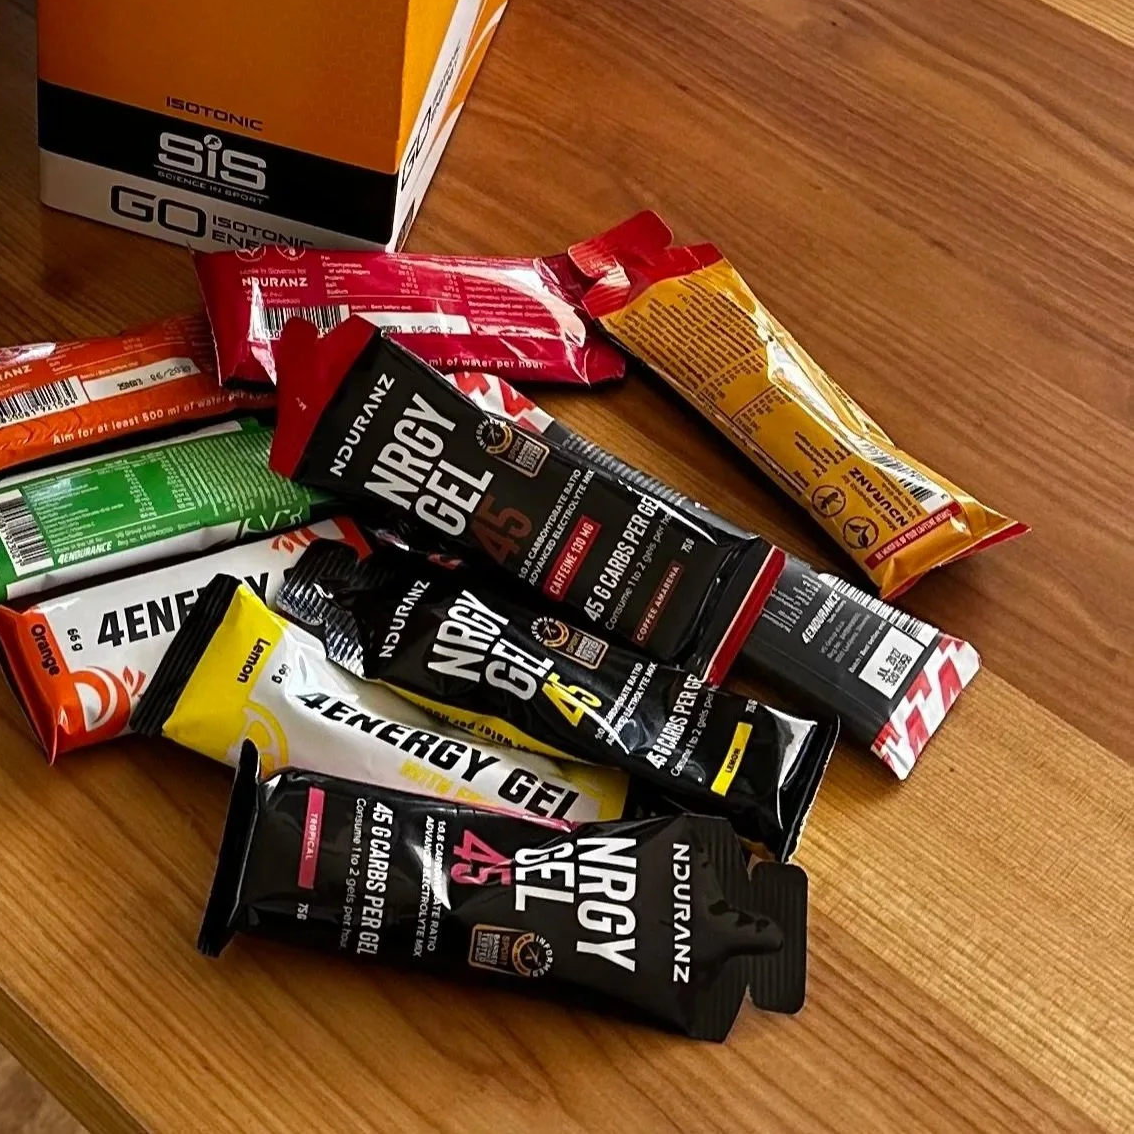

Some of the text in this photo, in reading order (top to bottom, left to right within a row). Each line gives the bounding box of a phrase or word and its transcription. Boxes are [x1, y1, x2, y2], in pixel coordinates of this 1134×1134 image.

[166, 95, 263, 132] ISOTONIC
[111, 185, 206, 238] GO
[157, 171, 264, 205] SCIENCE IN SPORT
[242, 276, 309, 287] NDURANZ
[447, 357, 514, 369] of water per
[52, 395, 226, 446] Aim for at least 500 ml of water
[330, 373, 395, 477] NDURANZ
[364, 393, 456, 510] NRGY
[415, 460, 494, 536] GEL
[528, 469, 581, 561] CARBOHYDRATE RATIO
[849, 467, 908, 527] NDURANZ
[58, 540, 112, 564] 4ENDURANCE
[471, 493, 532, 565] 45
[529, 486, 585, 586] ADVANCED ELECTROLYTE
[624, 515, 648, 547] PER
[549, 521, 595, 595] CAFFEINE 130 MG
[602, 541, 636, 589] CARBS
[605, 525, 666, 630] Consume to 2 gels per
[378, 579, 430, 658] NDURANZ
[583, 593, 605, 622] 45
[600, 585, 611, 601] G
[637, 599, 657, 641] COFFEE
[802, 590, 841, 644] 4ENDURANCE
[30, 624, 61, 677] Orange
[66, 627, 83, 653] 66 g
[237, 637, 271, 683] Lemon
[427, 589, 509, 683] NRGY
[271, 675, 282, 685] g
[485, 638, 555, 701] GEL
[627, 663, 643, 687] RATIO
[541, 672, 602, 728] 45
[662, 691, 696, 750] CARBS PER
[696, 693, 715, 734] gels per
[295, 692, 500, 782] 4ENERGY
[305, 812, 318, 859] TROPICAL
[343, 797, 366, 926] Consume to 2 gels per
[450, 829, 515, 886] 45
[357, 801, 394, 955] 45 G CARBS PER GEL
[515, 842, 575, 912] GEL
[576, 837, 637, 972] NRGY
[673, 843, 691, 983] NDURANZ
[413, 936, 424, 957] MIX
[427, 923, 439, 951] RATIO
